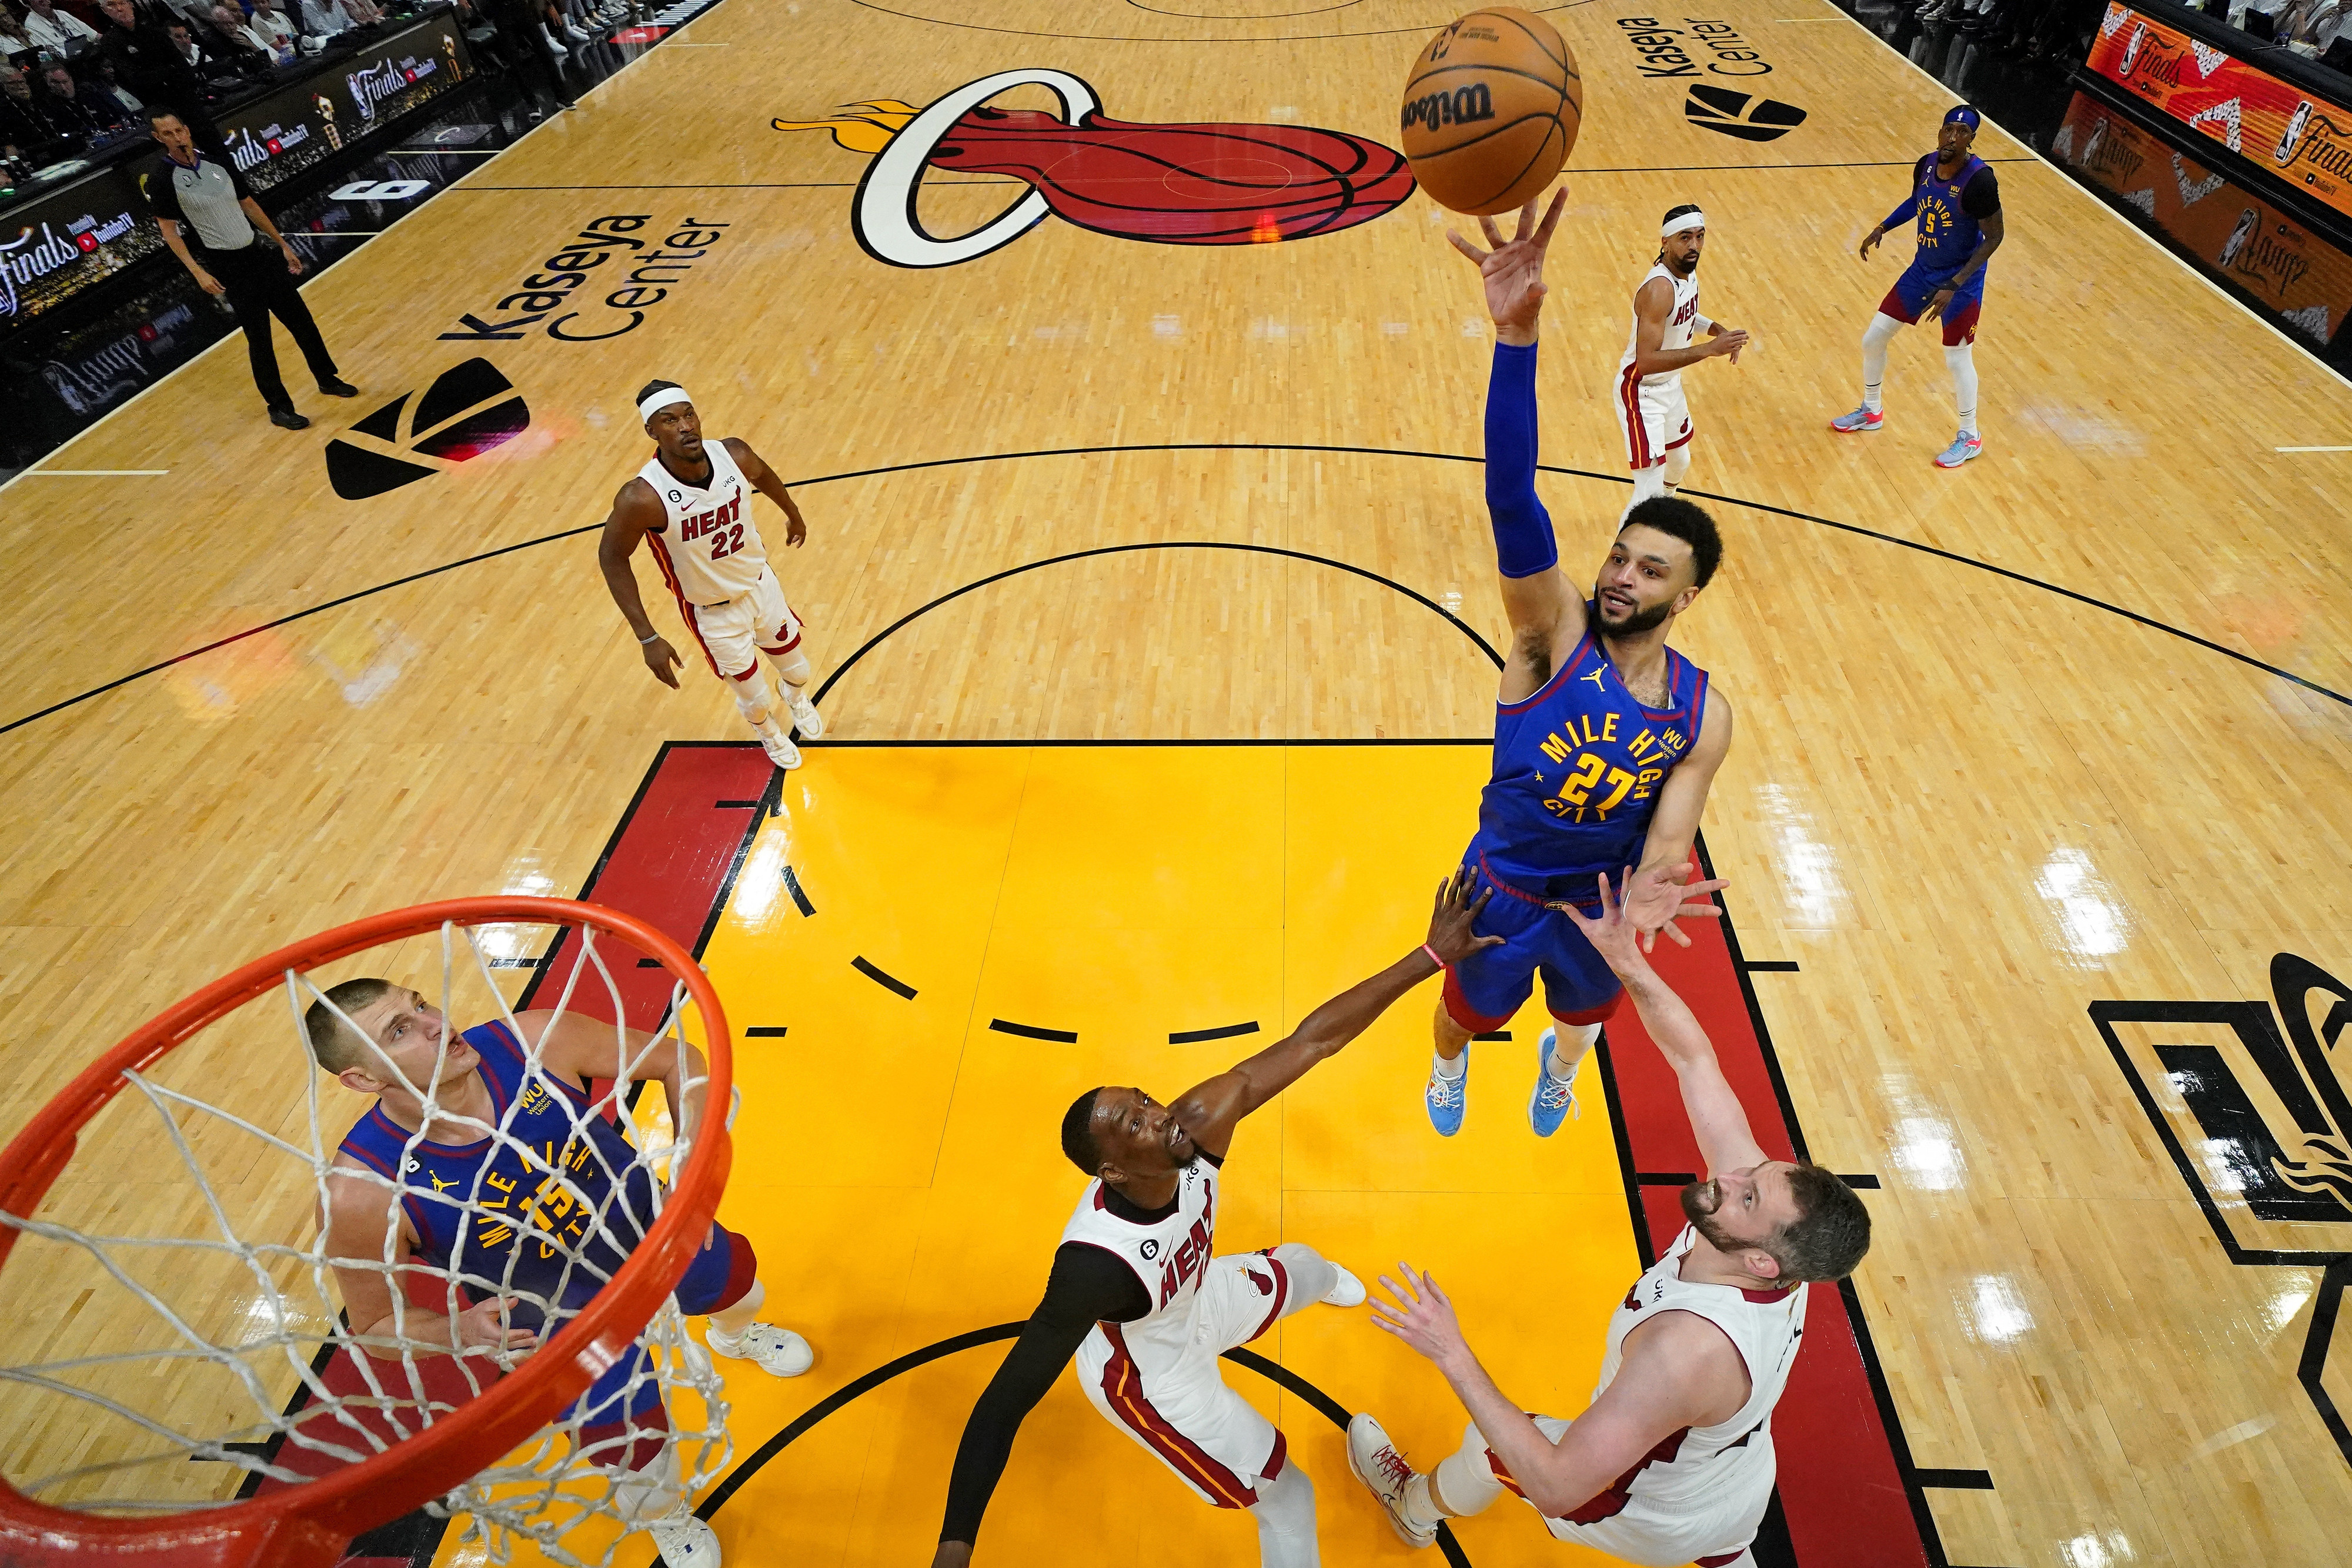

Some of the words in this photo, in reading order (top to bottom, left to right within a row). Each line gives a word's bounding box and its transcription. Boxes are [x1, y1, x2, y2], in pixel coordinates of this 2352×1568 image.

[1617, 17, 1703, 77] Kaseya
[1683, 18, 1772, 75] Center
[2120, 32, 2186, 88] Finals
[357, 58, 407, 123] Finals
[1400, 82, 1495, 132] Wilson
[2276, 115, 2352, 184] Final
[1917, 196, 1932, 218] MILE
[1934, 199, 1953, 227] HIGH
[1925, 212, 1935, 233] 5
[1917, 233, 1938, 248] CITY
[436, 215, 653, 340] Kaseya
[547, 217, 730, 342] Center
[670, 491, 680, 502] 6
[721, 476, 735, 487] UKG
[681, 484, 741, 542] HEAT
[711, 523, 744, 560] 22
[1539, 713, 1621, 764] MILE
[1627, 728, 1664, 799] HIGH
[1657, 738, 1676, 758] Western
[1662, 727, 1687, 750] WU
[1558, 753, 1637, 813] 27
[1543, 798, 1606, 823] CITY
[521, 1083, 544, 1108] WU
[527, 1093, 551, 1115] Western
[535, 1100, 553, 1115] Union
[477, 1171, 517, 1249] MILE
[518, 1176, 574, 1232] 15
[1142, 1241, 1157, 1258] 6
[1651, 1278, 1663, 1303] UK
